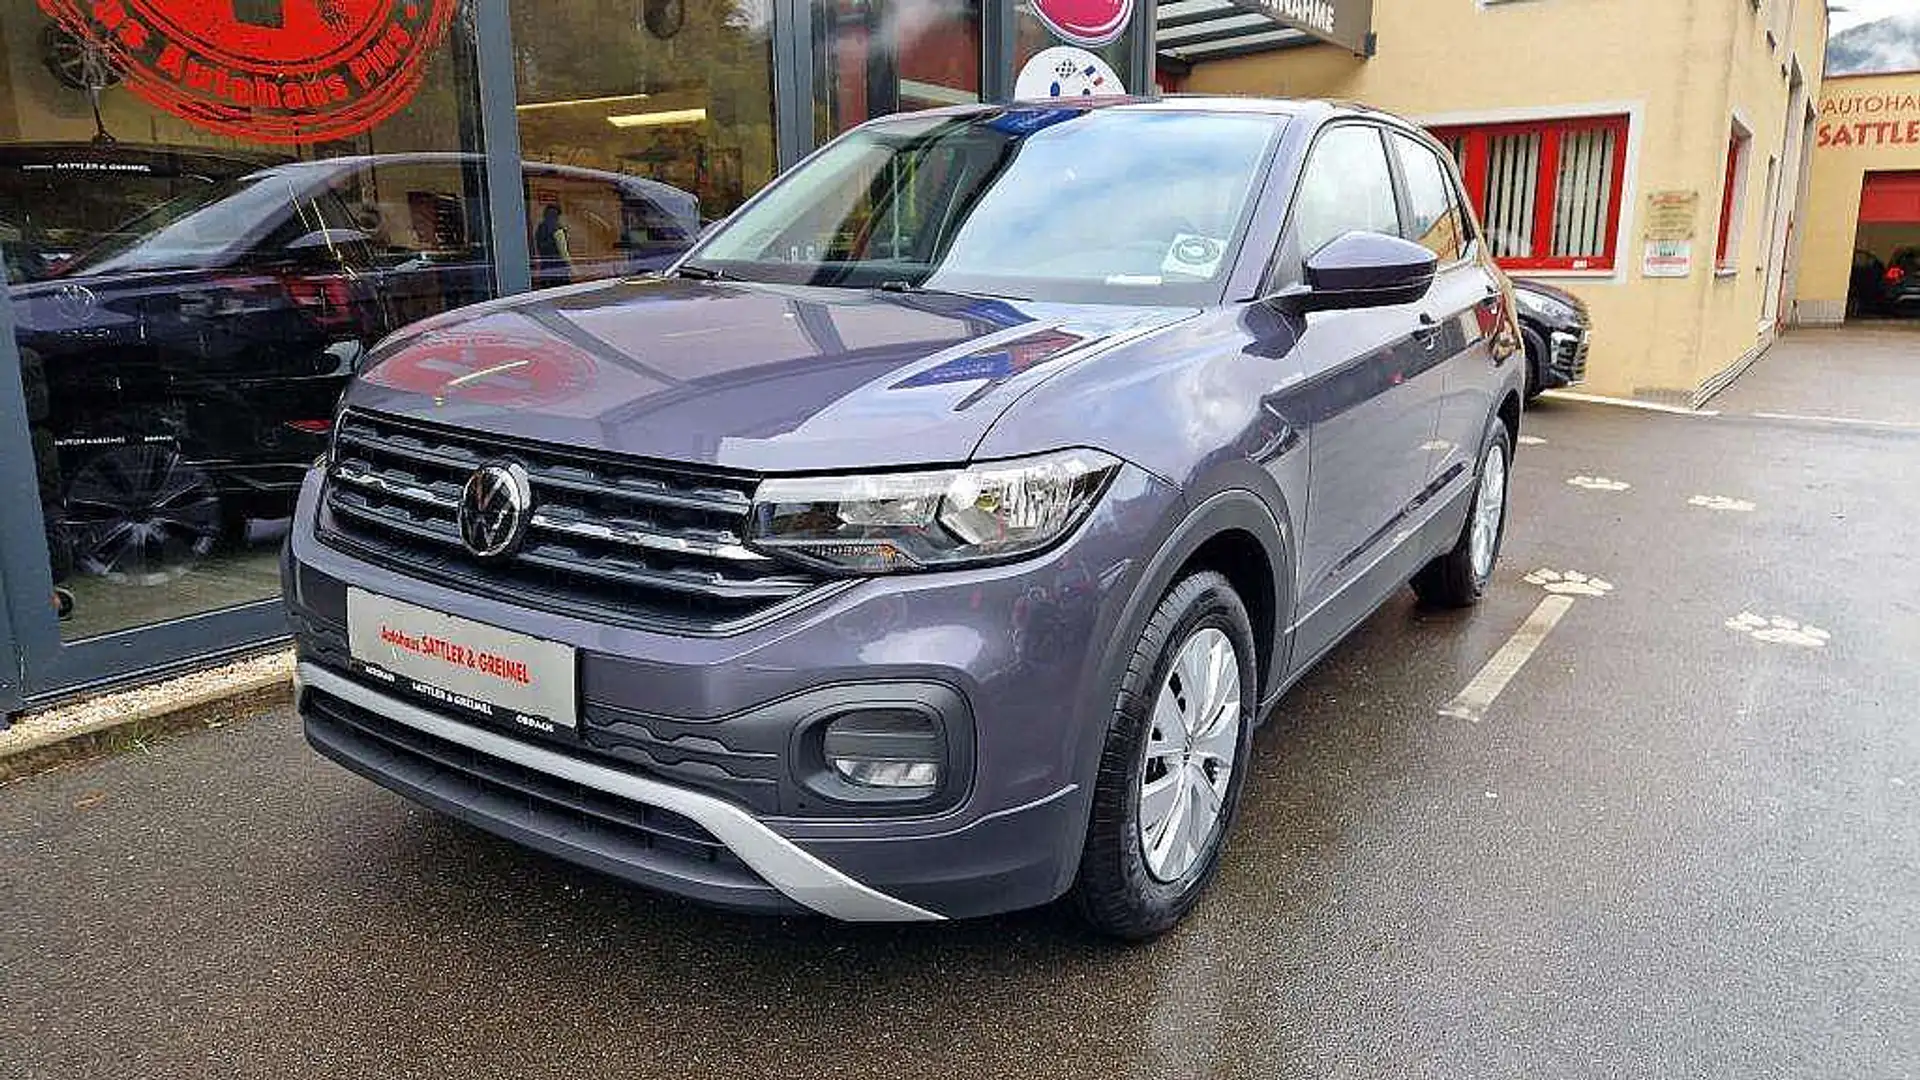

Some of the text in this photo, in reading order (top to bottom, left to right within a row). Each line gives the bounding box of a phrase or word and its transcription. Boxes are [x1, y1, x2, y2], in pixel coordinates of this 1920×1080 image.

[156, 43, 348, 109] Autohaus
[351, 23, 410, 90] Plus
[1822, 95, 1920, 115] AUTOHA
[1817, 120, 1920, 147] SATTLE
[421, 635, 466, 665] SATTLER
[466, 649, 476, 669] &
[478, 652, 531, 684] GREIMEL
